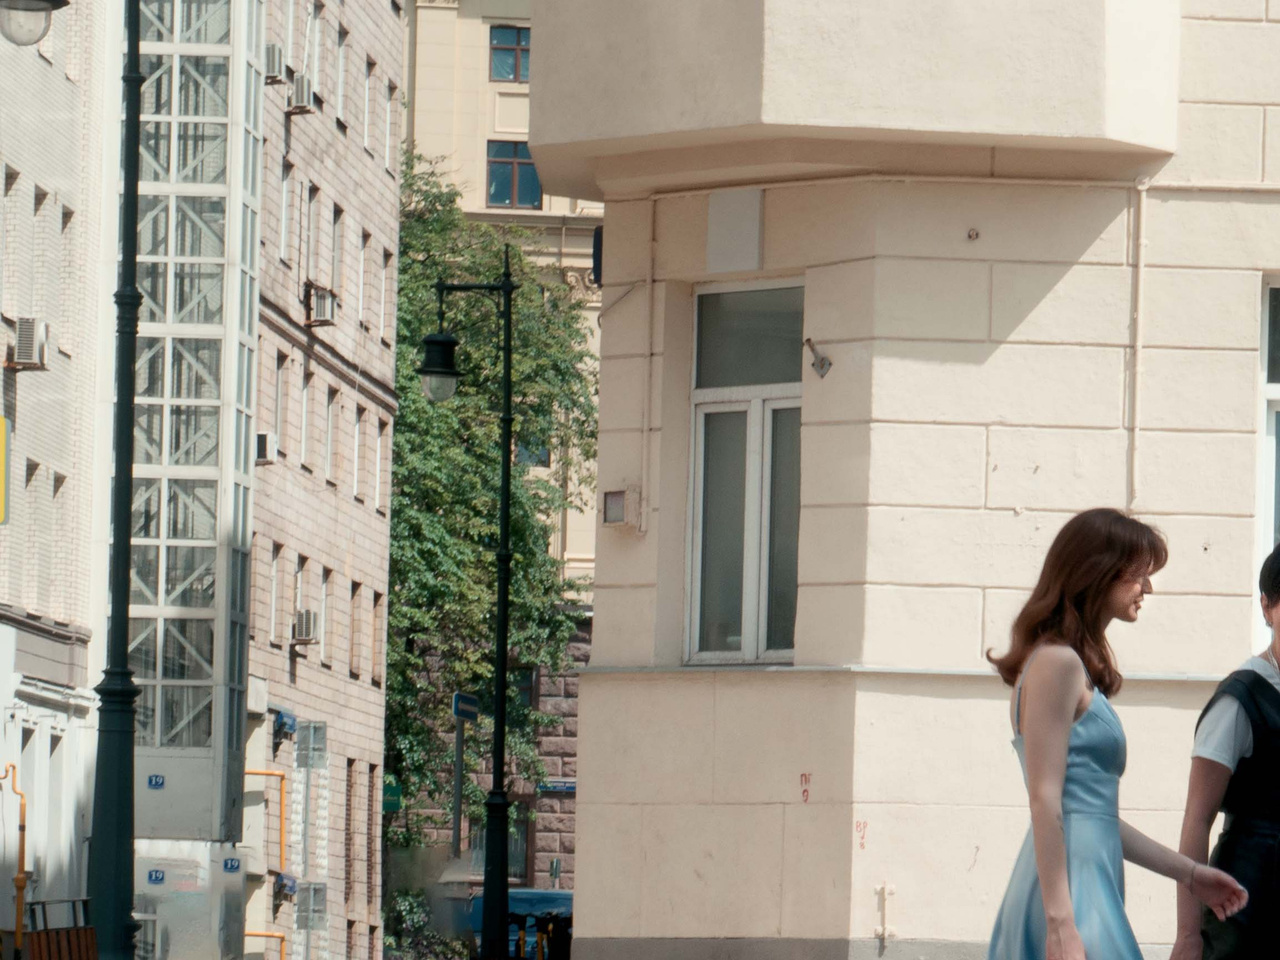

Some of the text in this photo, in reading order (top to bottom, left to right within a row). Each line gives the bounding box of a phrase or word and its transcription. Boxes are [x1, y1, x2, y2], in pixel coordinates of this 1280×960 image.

[151, 776, 163, 785] 19
[226, 860, 239, 869] 19
[150, 871, 163, 881] 19
